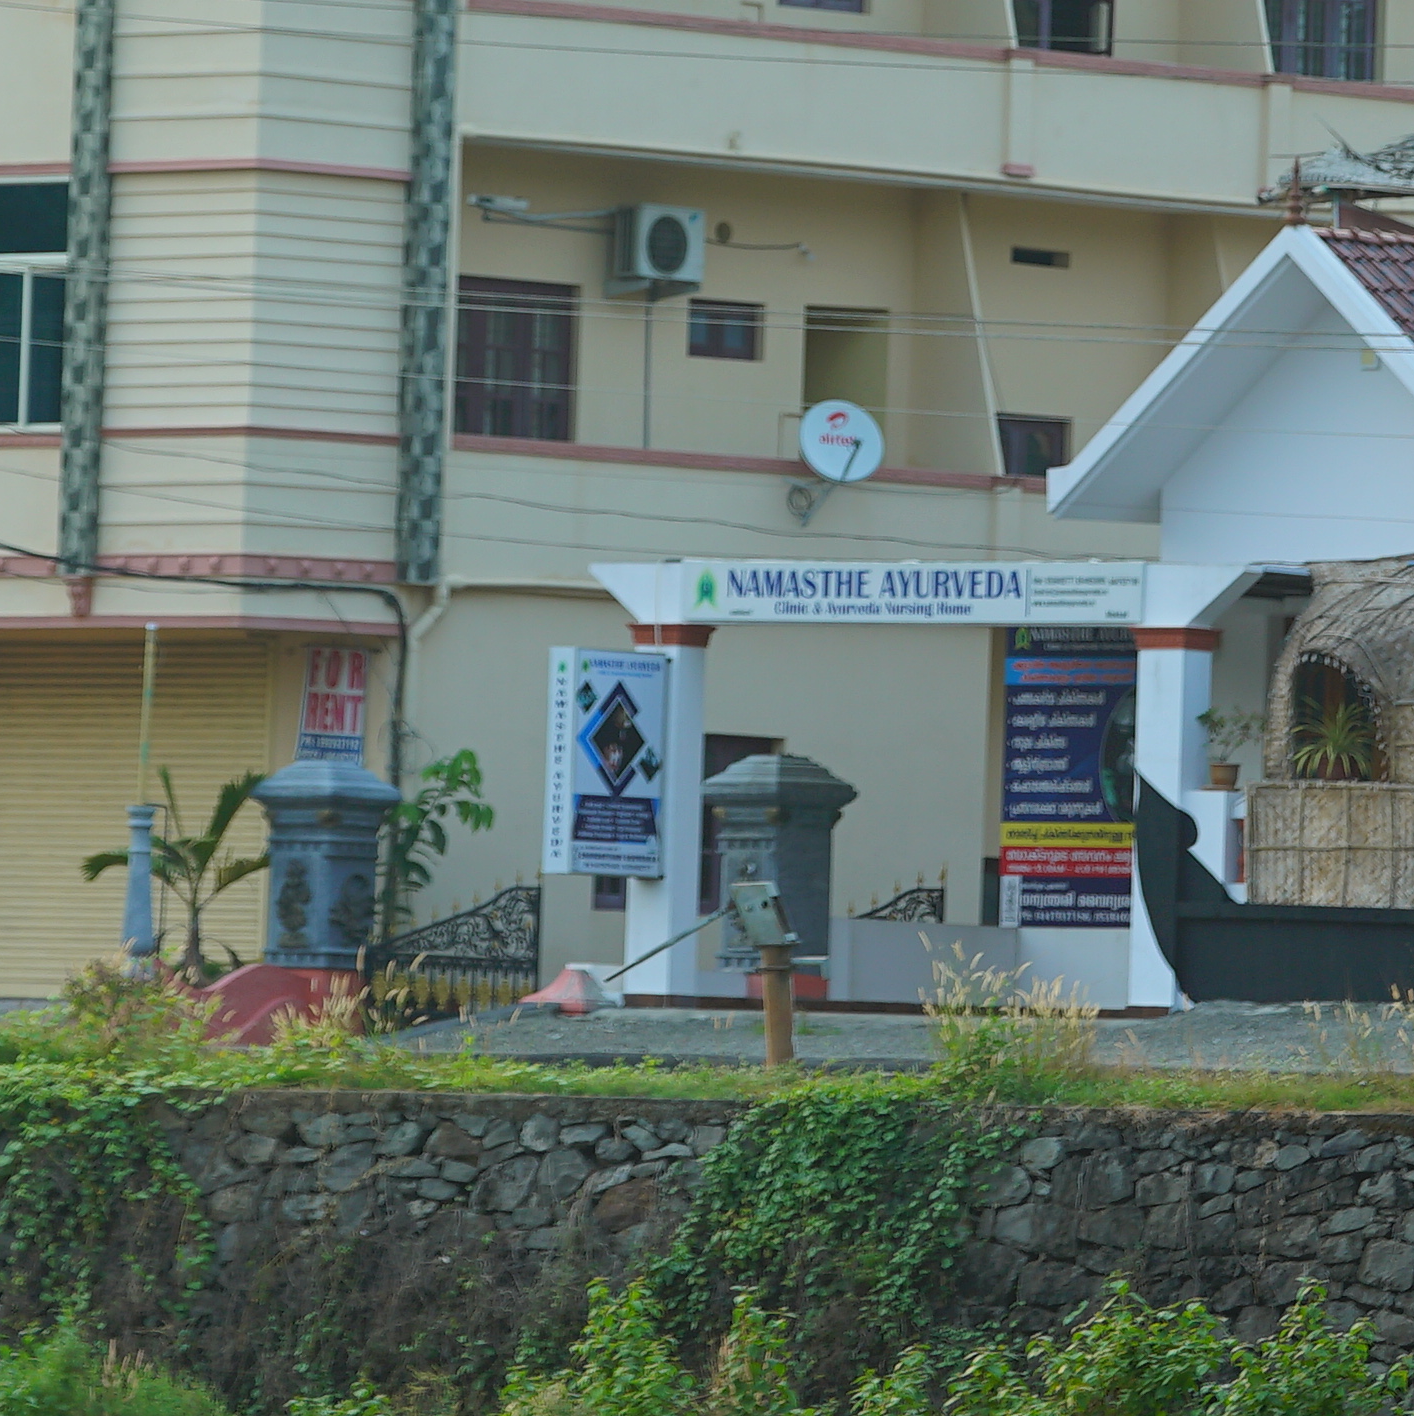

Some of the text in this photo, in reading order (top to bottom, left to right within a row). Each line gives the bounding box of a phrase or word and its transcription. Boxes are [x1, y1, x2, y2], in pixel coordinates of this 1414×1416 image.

[727, 569, 1021, 599] NAMASTHE AYURVEDA
[773, 603, 808, 615] Clinic
[825, 602, 880, 616] Ayurveda
[884, 602, 934, 617] Nursing
[936, 603, 971, 615] Home
[309, 649, 364, 689] FOR
[304, 692, 364, 734] RENT
